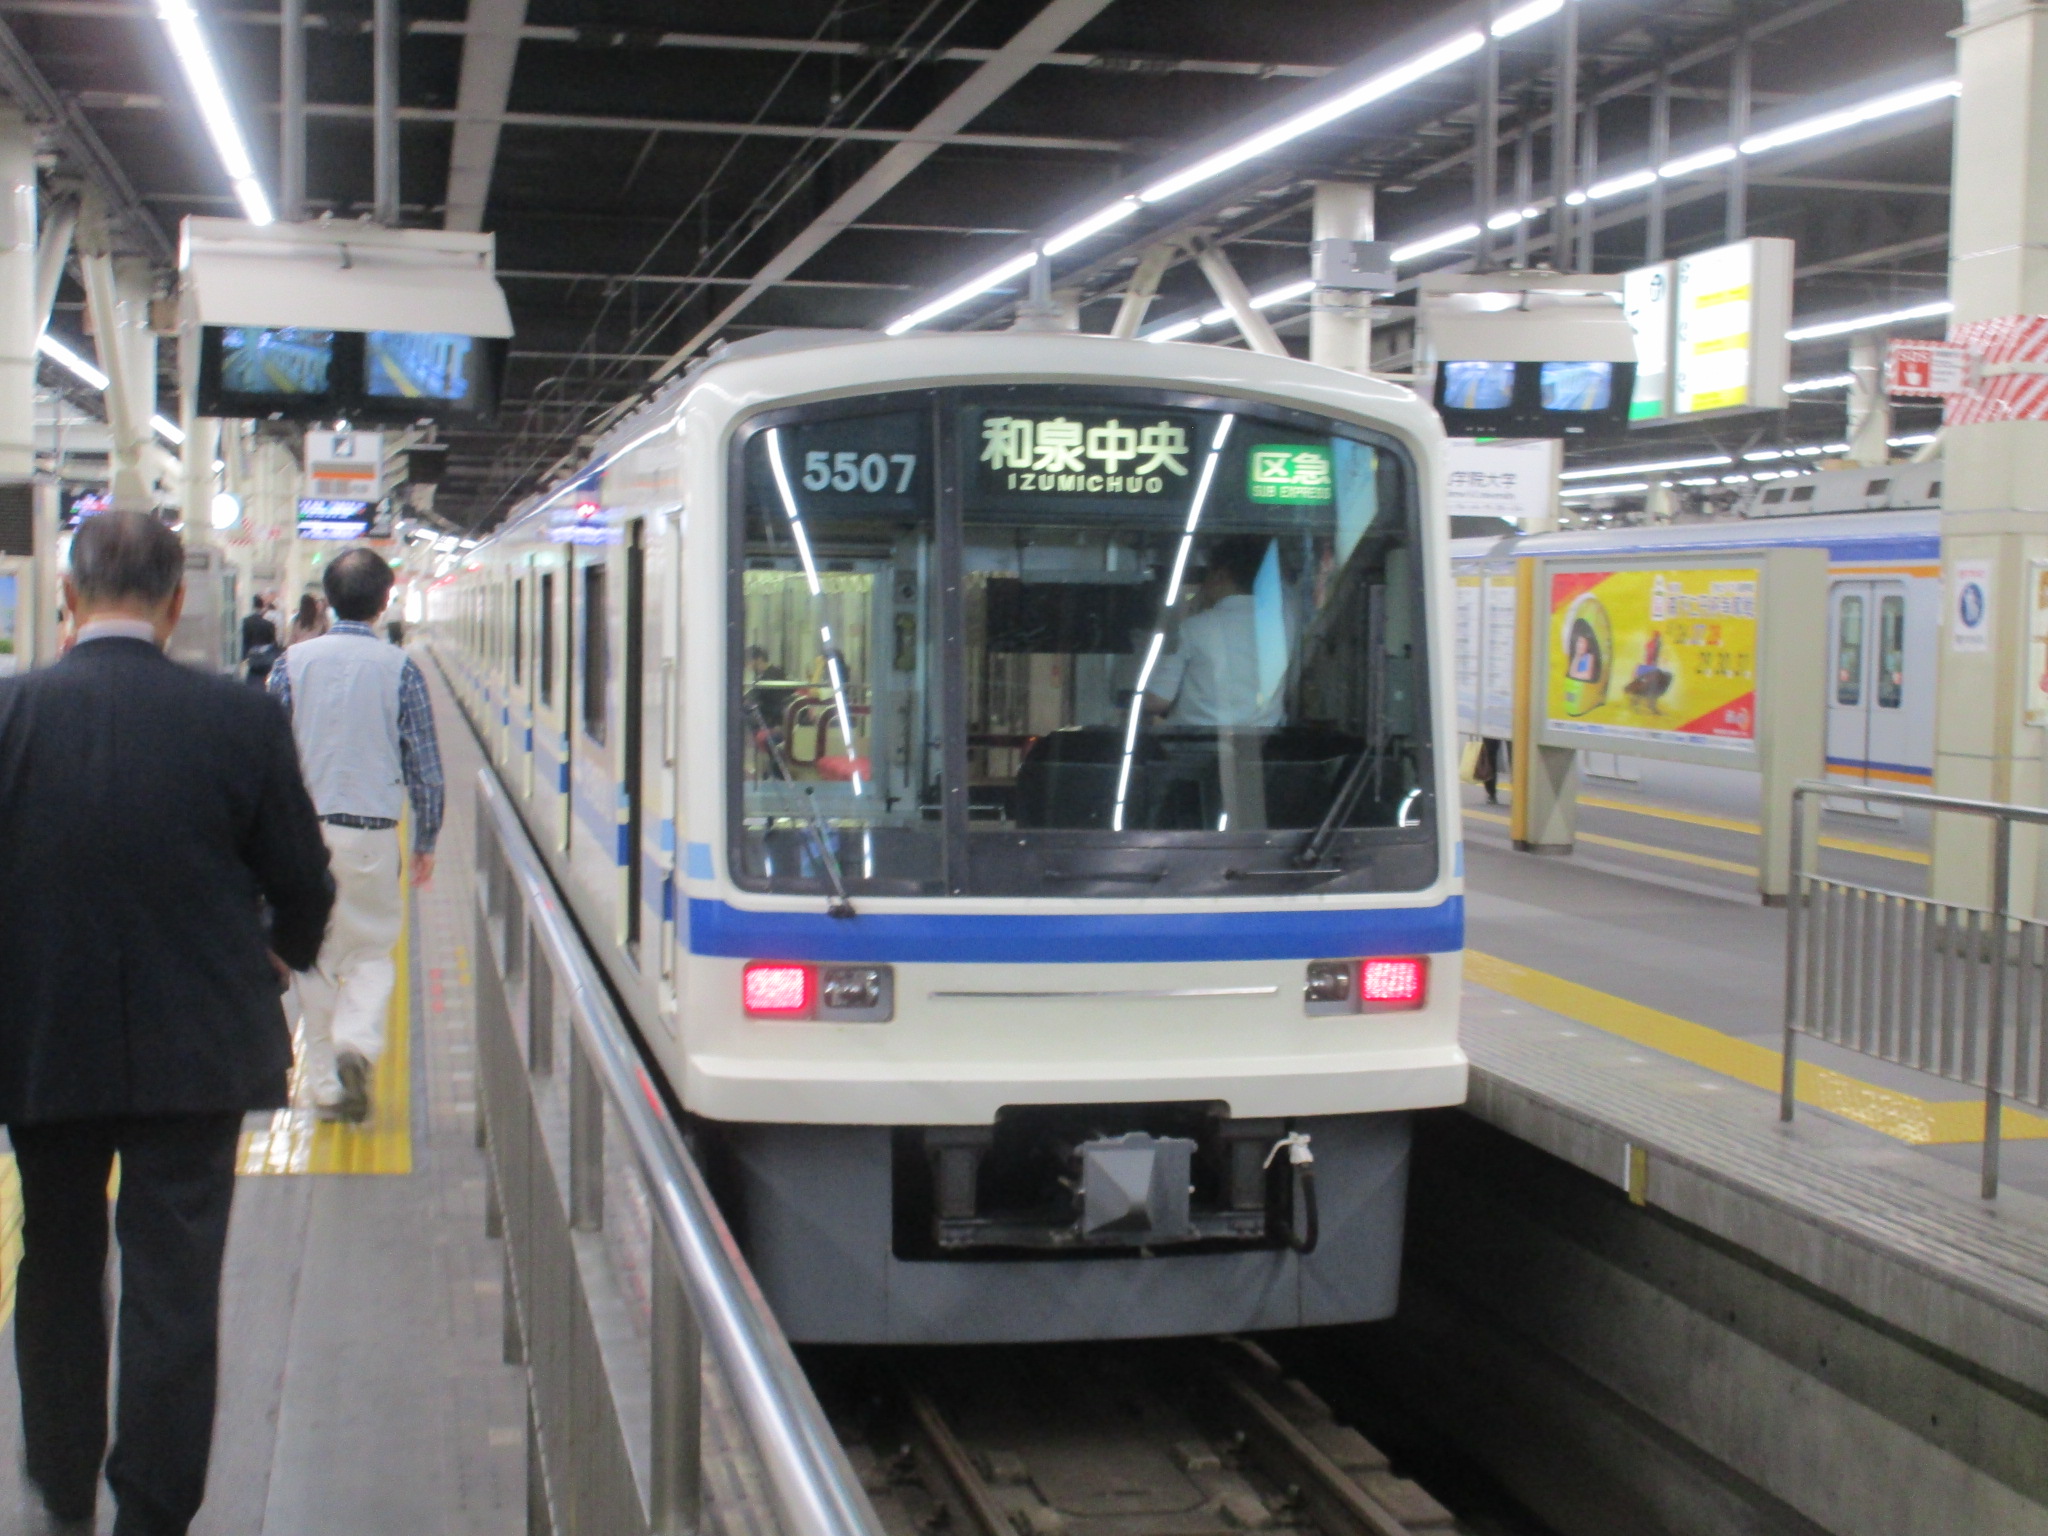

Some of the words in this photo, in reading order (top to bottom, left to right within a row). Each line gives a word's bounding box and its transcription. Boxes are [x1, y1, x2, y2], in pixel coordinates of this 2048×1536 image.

[980, 417, 1189, 477] 和泉中央
[803, 451, 916, 494] 5507
[1253, 452, 1331, 485] 区急
[1447, 471, 1518, 489] 学院大学
[1007, 474, 1164, 495] IZUMICHUO
[1252, 485, 1276, 498] SUB
